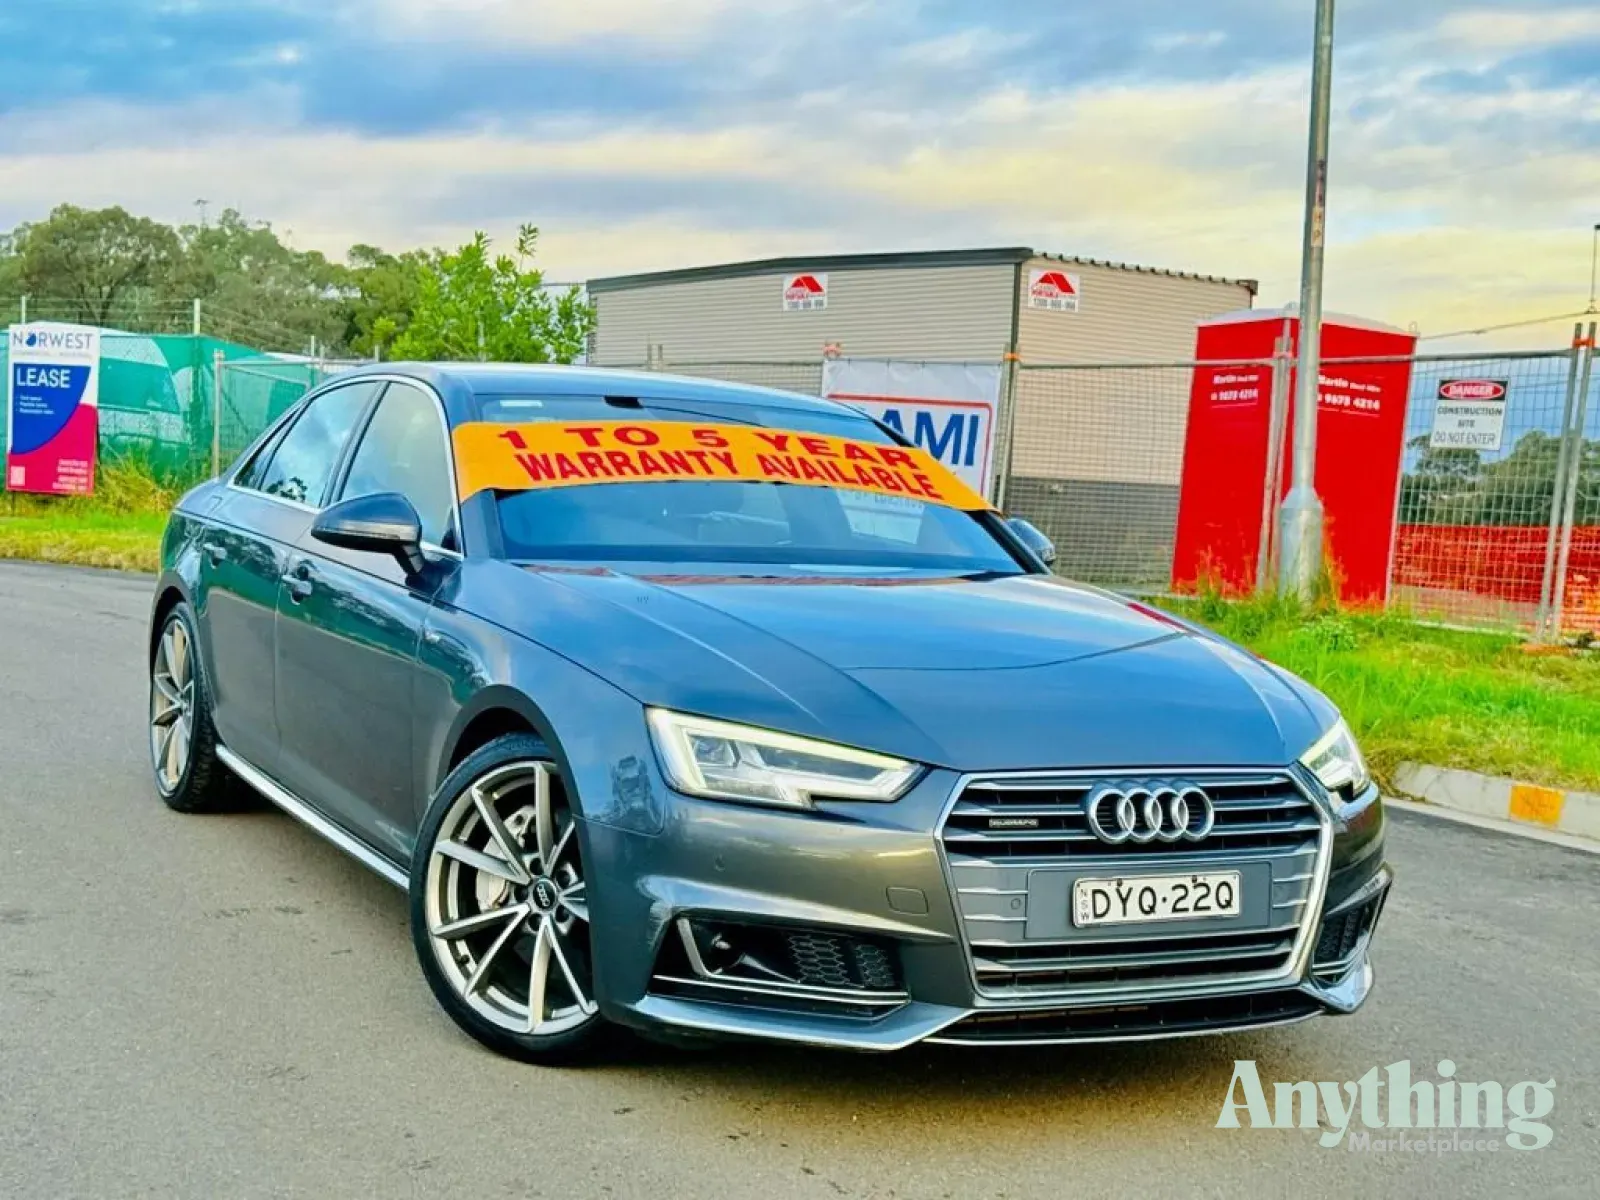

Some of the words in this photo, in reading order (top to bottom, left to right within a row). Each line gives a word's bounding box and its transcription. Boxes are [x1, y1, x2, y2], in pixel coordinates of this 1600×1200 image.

[16, 367, 71, 389] LEASE
[1449, 385, 1494, 396] DANGER
[1437, 406, 1503, 416] CONSTRUCTION
[1434, 431, 1447, 443] DO
[1448, 432, 1465, 444] NOT
[1466, 432, 1496, 445] ENTER
[498, 430, 528, 450] 1
[563, 427, 660, 447] TO
[692, 429, 730, 448] 5
[754, 432, 921, 471] YEAR
[514, 450, 741, 481] WARRANTY
[756, 453, 945, 500] AVAILABLE
